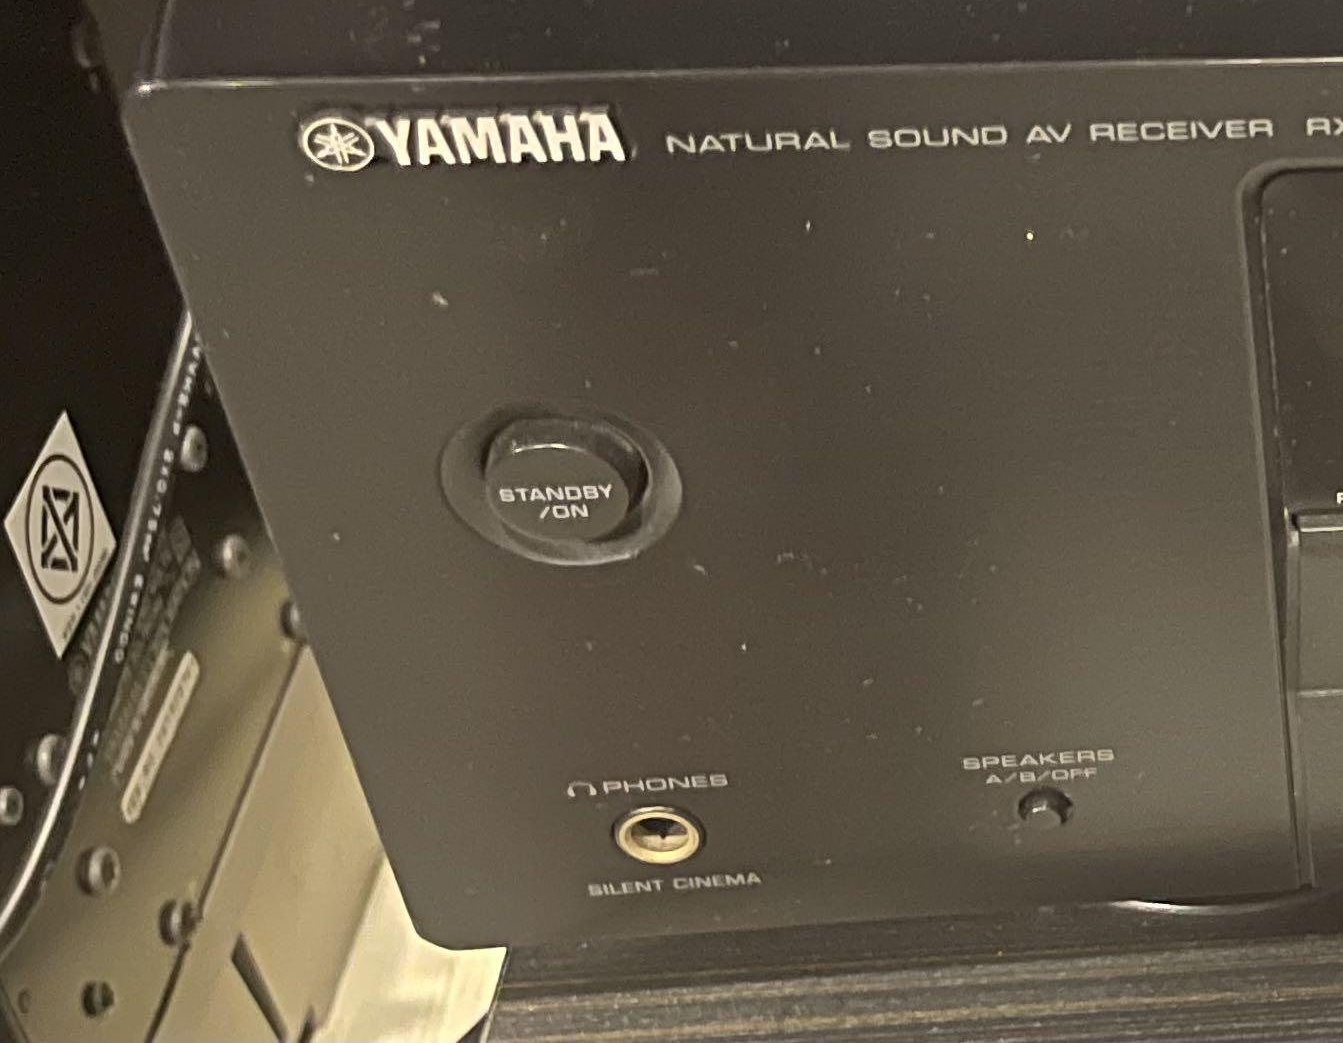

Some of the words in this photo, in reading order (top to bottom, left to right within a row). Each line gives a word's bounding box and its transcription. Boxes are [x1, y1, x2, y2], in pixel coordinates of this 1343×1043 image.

[374, 111, 627, 167] YAMAHA
[665, 129, 850, 155] NATURAL
[867, 125, 1008, 150] SOUND
[1025, 121, 1073, 144] AV
[1089, 118, 1274, 143] RECEIVER
[499, 484, 613, 503] STANDBY
[539, 504, 590, 520] /ON
[962, 748, 1115, 771] SPEAKERS
[603, 773, 729, 795] PHONES
[985, 767, 1098, 785] A/B/OFF
[587, 880, 664, 898] SILENT
[672, 872, 762, 891] CINEMA
